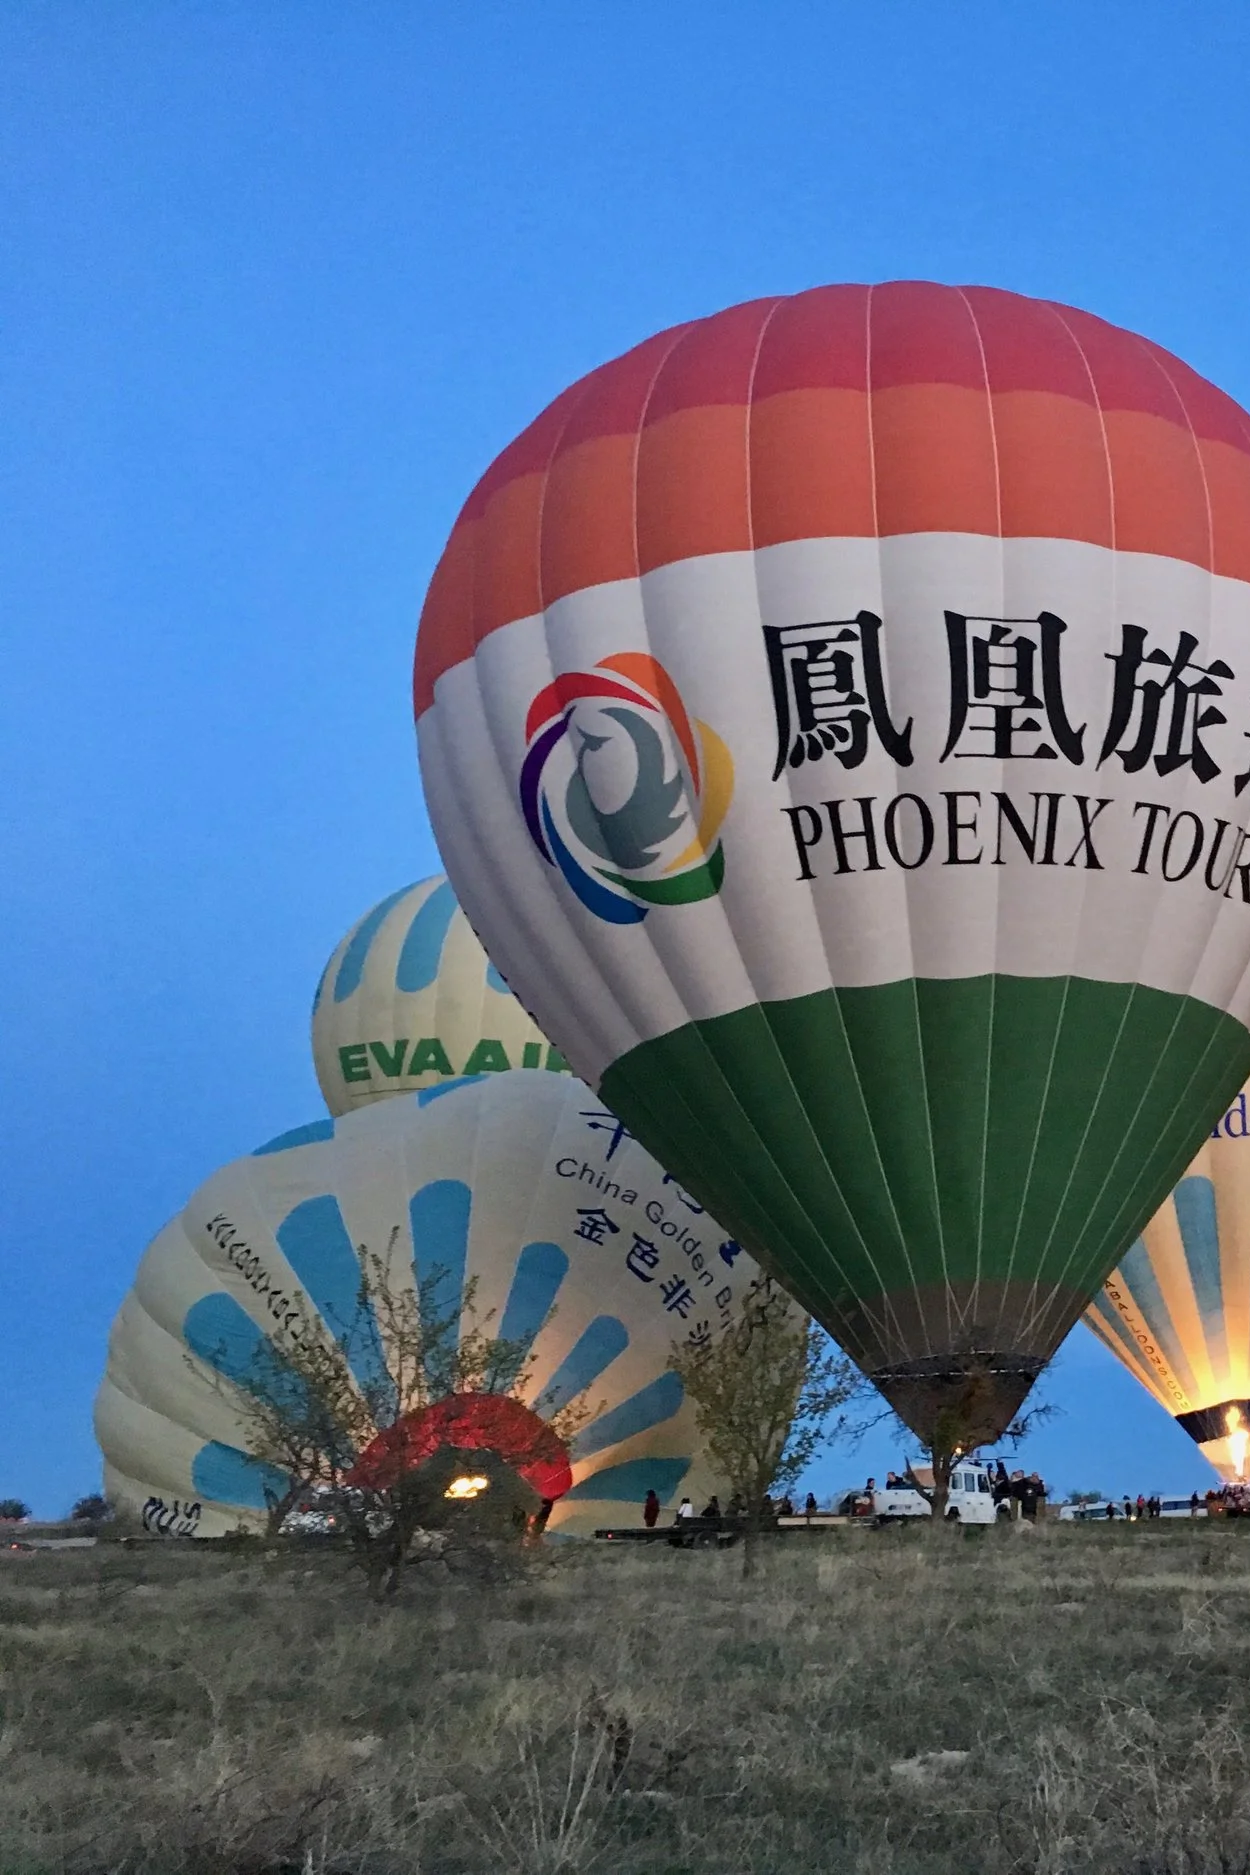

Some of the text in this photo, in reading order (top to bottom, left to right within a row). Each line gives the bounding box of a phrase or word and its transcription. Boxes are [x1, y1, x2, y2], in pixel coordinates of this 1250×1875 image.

[780, 791, 1115, 882] PHOENIX
[338, 1038, 455, 1083] EVA
[556, 1158, 639, 1206] China
[646, 1201, 715, 1287] Golden
